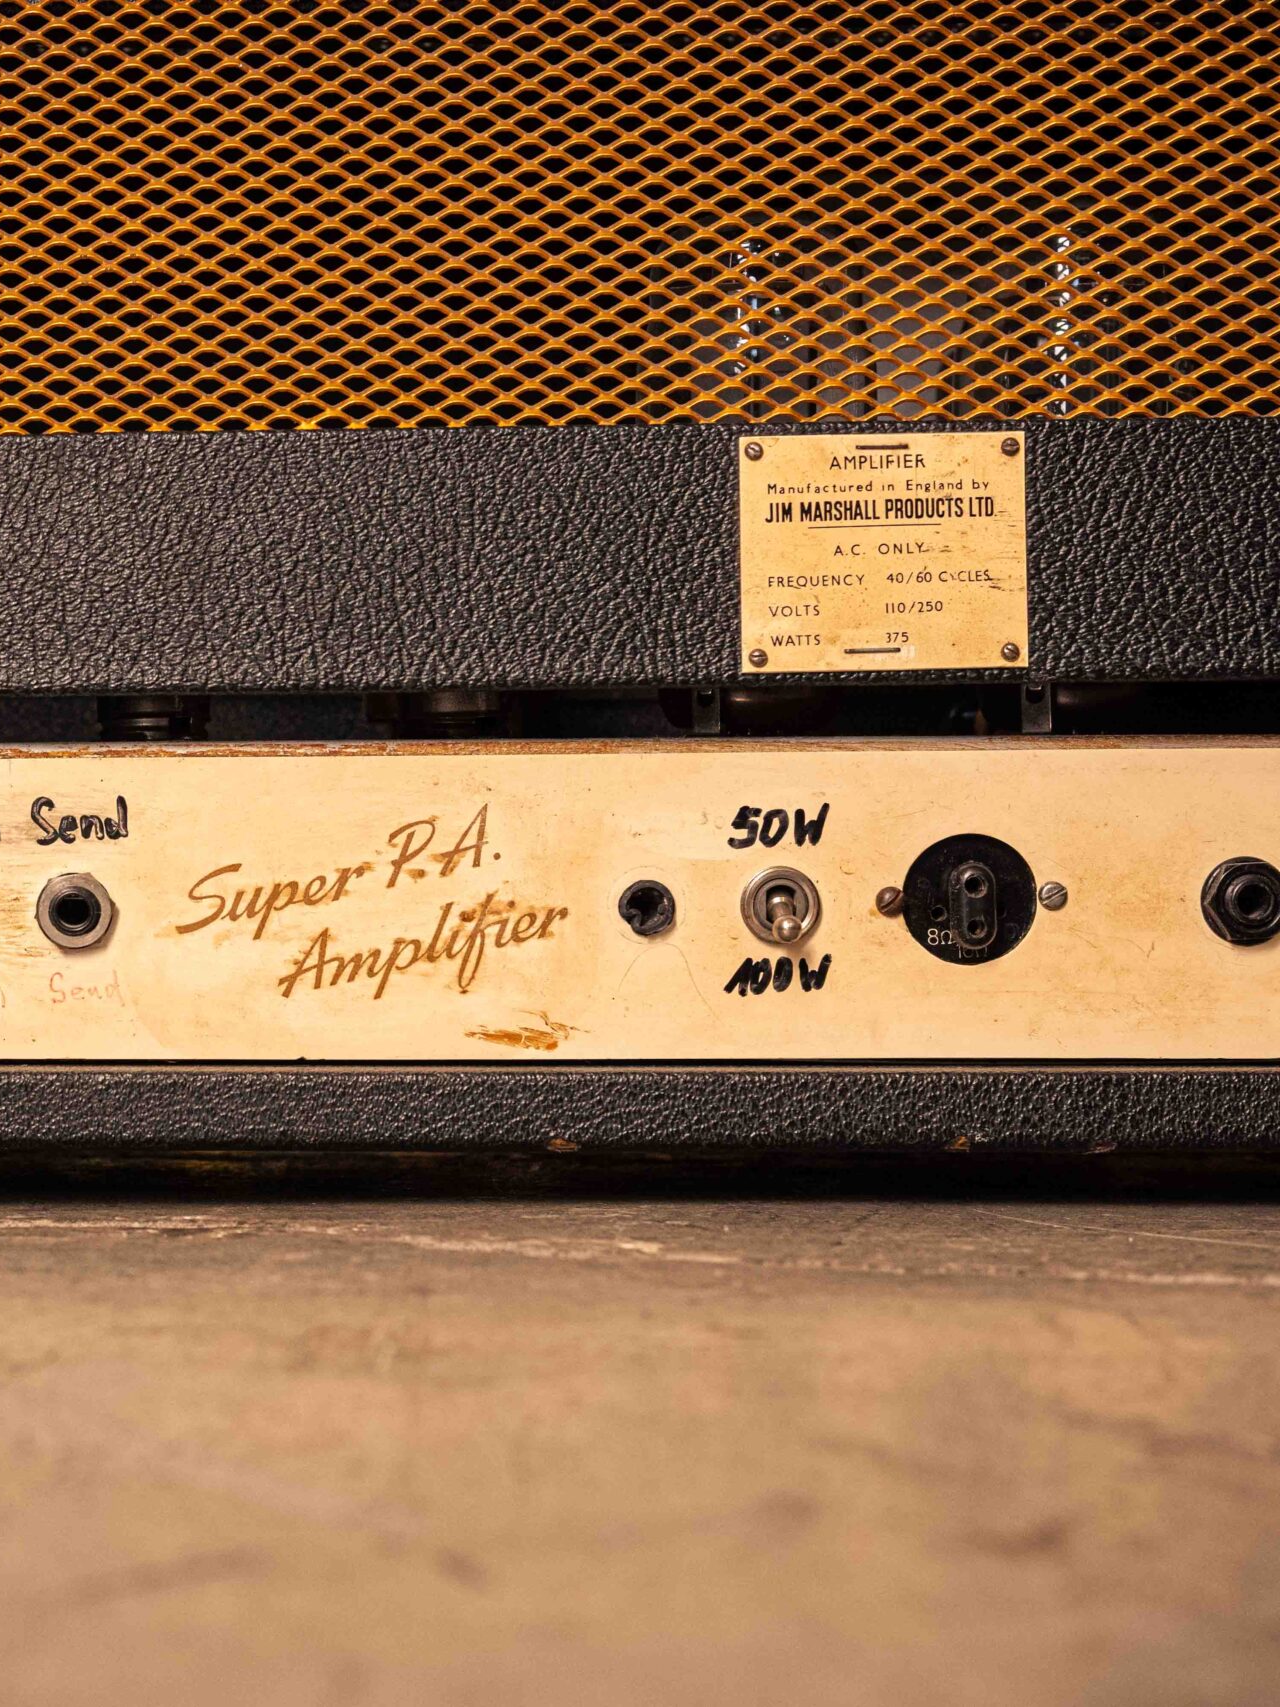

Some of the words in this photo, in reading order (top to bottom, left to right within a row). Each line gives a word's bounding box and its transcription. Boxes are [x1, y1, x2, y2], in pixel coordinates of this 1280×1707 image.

[829, 454, 926, 470] AMPLIFIER
[767, 482, 873, 495] Manufactured
[882, 482, 895, 492] in
[906, 480, 963, 494] England
[972, 479, 990, 492] by
[765, 502, 793, 523] JIM
[800, 498, 880, 522] MARSHALL
[885, 497, 964, 520] PRODUCTS
[833, 543, 866, 557] A.C.
[878, 542, 926, 556] ONLY
[768, 574, 865, 588] FREQUENCY
[886, 571, 933, 584] 40/60
[768, 604, 820, 617] VOLTS
[885, 600, 943, 614] 110/250
[770, 634, 821, 647] WATTS
[885, 632, 910, 644] 375
[31, 795, 129, 846] Send
[175, 863, 366, 940] Super
[278, 890, 570, 999] Amplifier
